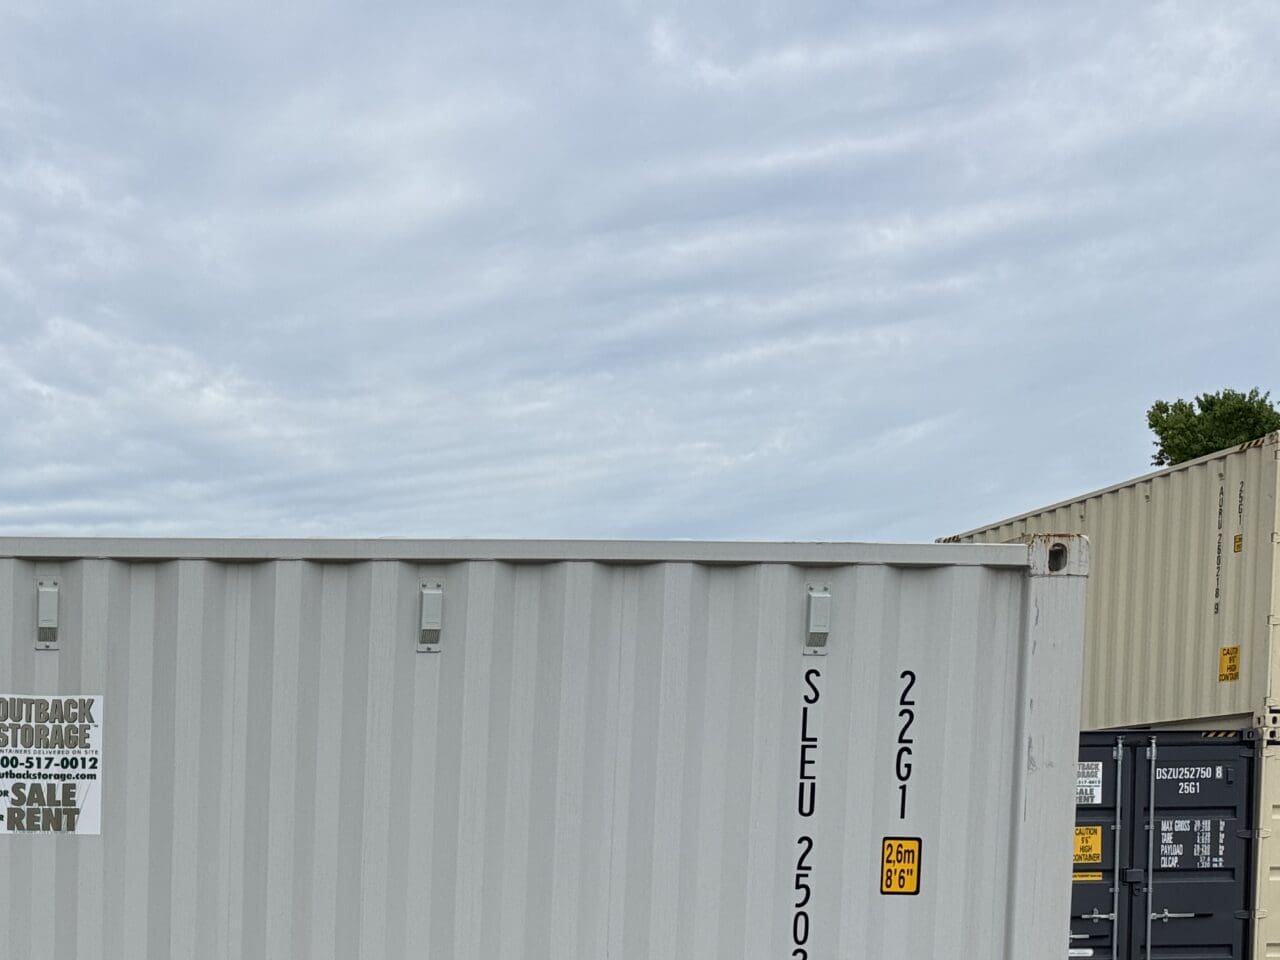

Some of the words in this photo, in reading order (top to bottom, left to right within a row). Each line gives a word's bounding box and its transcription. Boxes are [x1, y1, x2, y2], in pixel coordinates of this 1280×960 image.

[798, 668, 821, 818] SLEU
[895, 670, 916, 820] 22G1
[1156, 766, 1212, 779] DSZU252750
[1215, 765, 1223, 779] 8
[10, 782, 77, 807] SALE
[1178, 782, 1200, 794] 25G1
[6, 807, 80, 831] RENT
[885, 843, 915, 865] 2,6m
[1160, 844, 1184, 856] PAYLOAD
[885, 868, 914, 889] 8'6"
